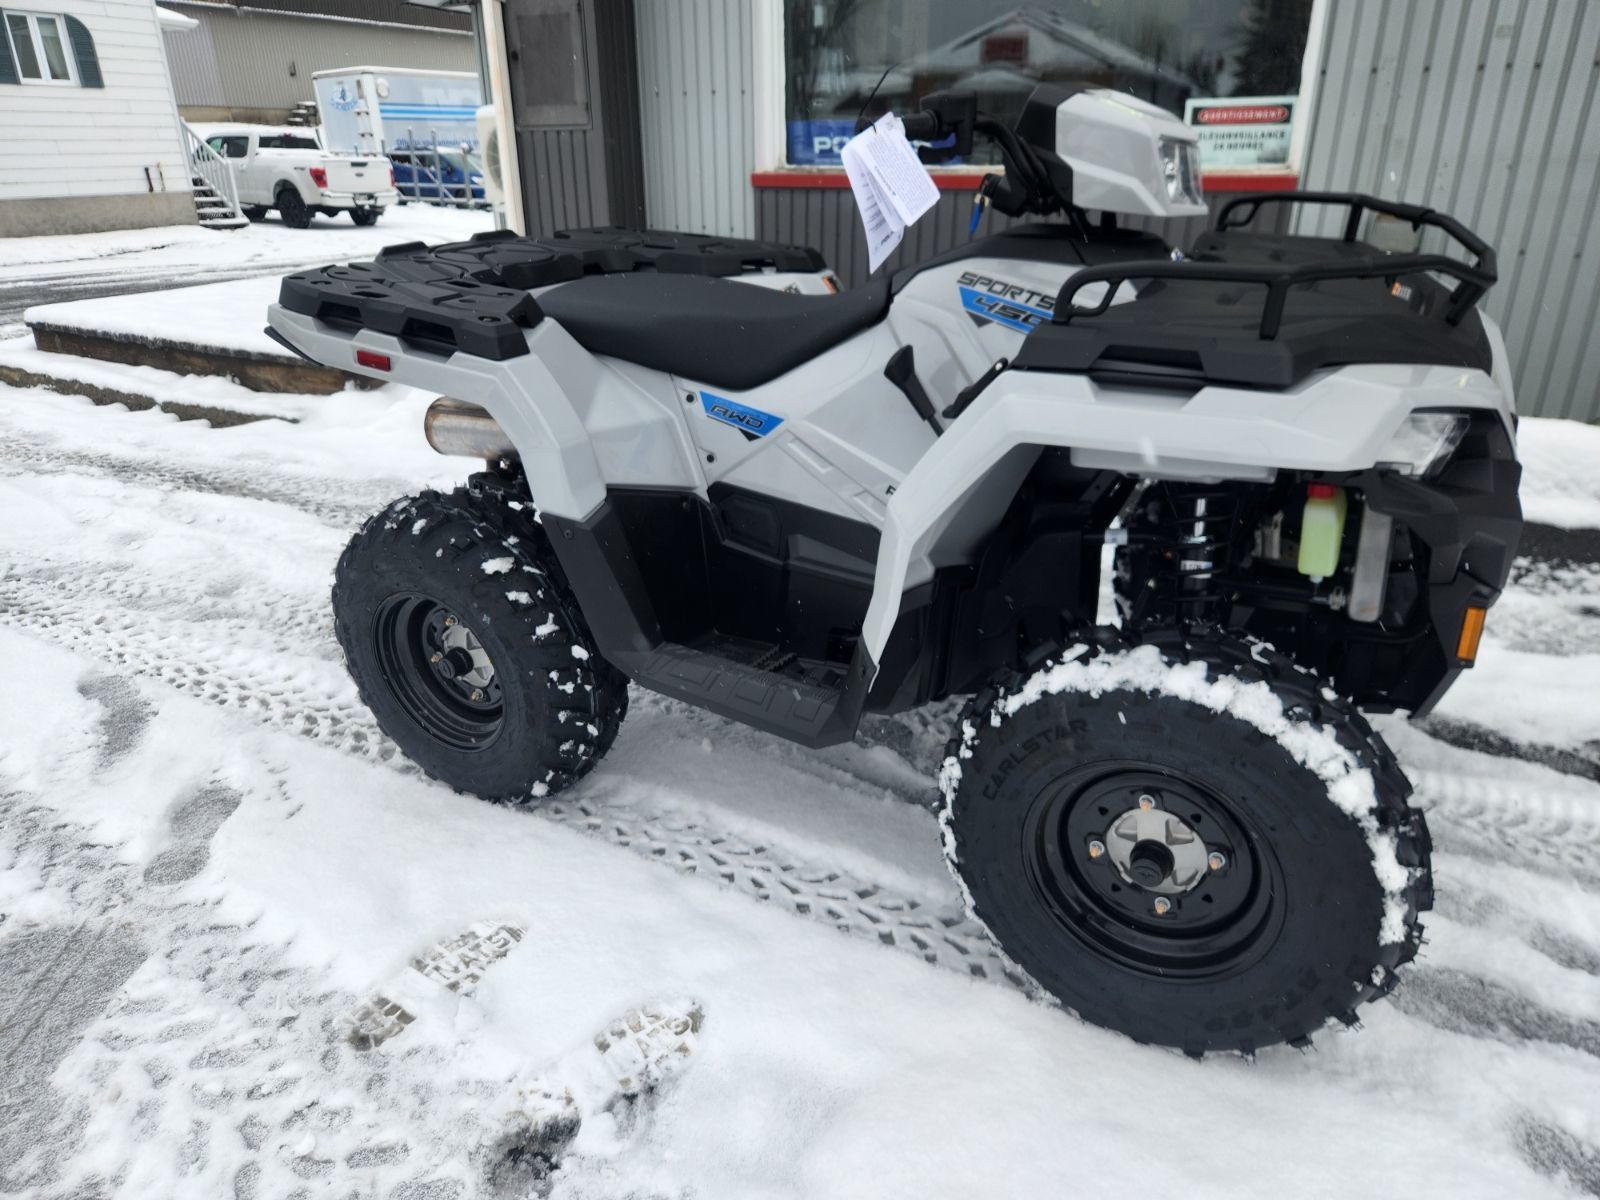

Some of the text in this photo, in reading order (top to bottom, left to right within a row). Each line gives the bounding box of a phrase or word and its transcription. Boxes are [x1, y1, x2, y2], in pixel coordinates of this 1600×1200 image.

[956, 271, 1058, 311] SPORTS
[710, 403, 765, 429] AWD
[982, 717, 1089, 801] CARLSTAR
